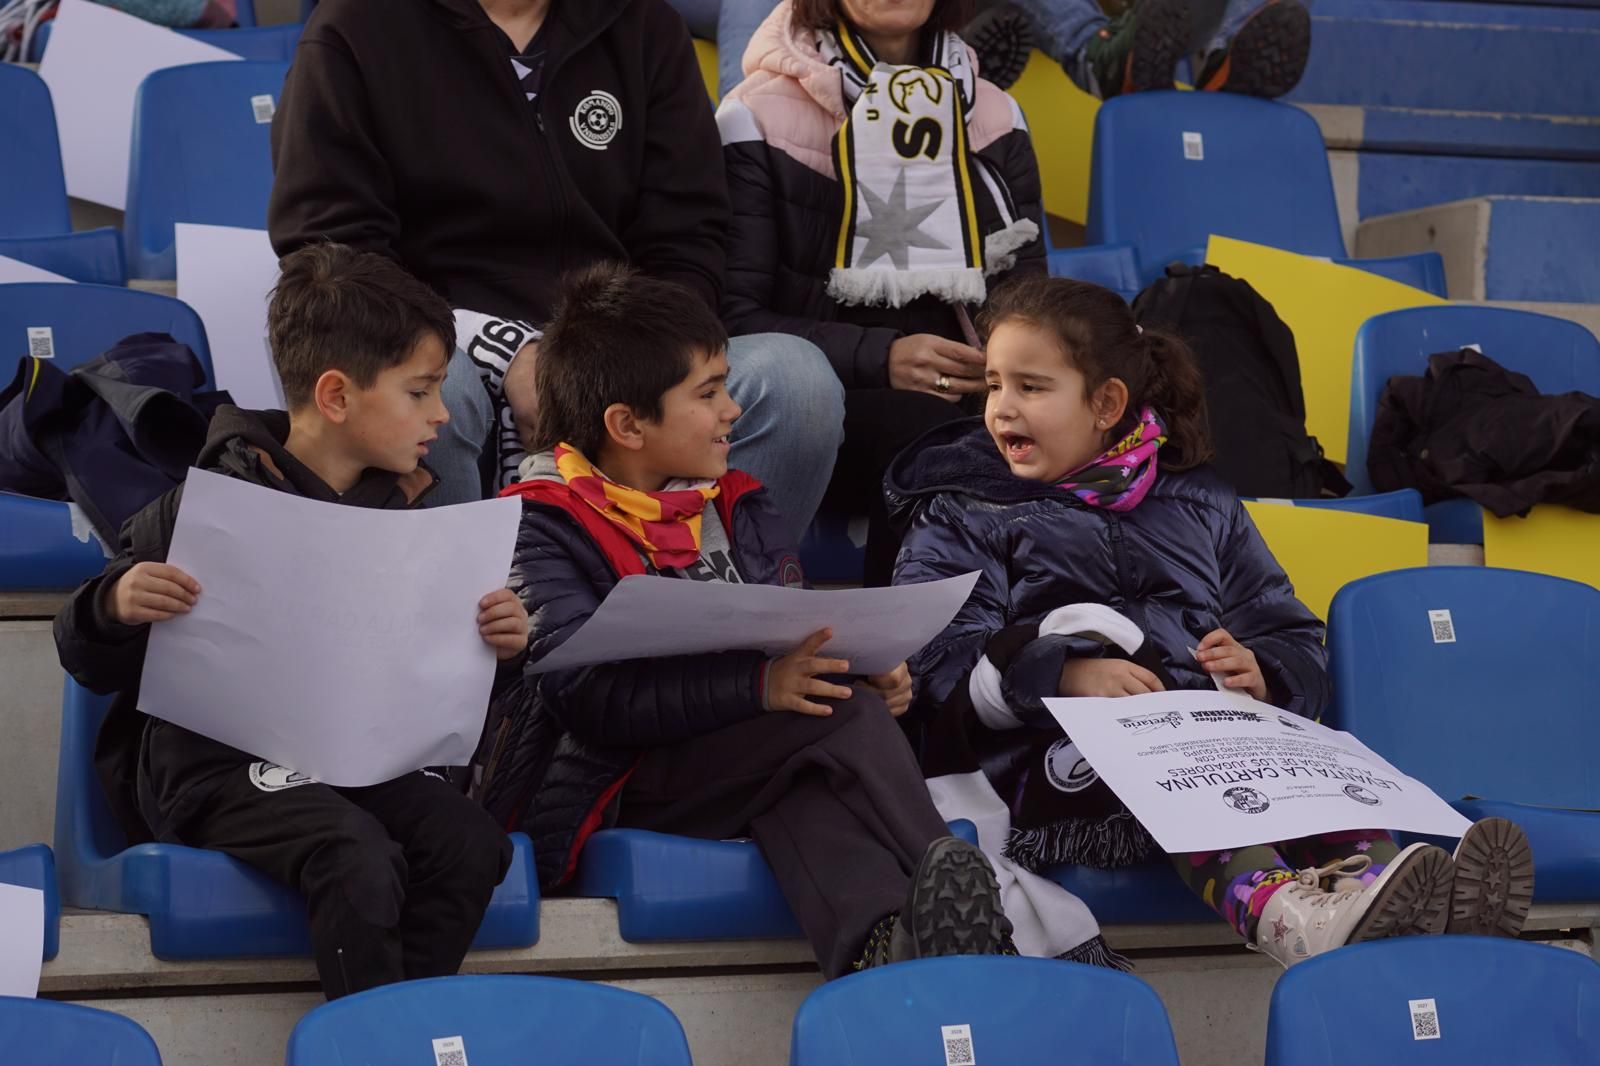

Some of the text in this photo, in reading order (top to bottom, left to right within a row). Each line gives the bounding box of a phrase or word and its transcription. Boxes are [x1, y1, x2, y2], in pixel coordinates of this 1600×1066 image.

[579, 99, 615, 116] KOMANDO
[1190, 710, 1256, 718] MONTSERRAT
[1170, 720, 1181, 729] el
[1183, 748, 1218, 757] EQUIPO
[1220, 745, 1264, 753] NUESTRO
[1194, 755, 1216, 764] CON
[1217, 751, 1259, 760] MOSAICO
[1250, 758, 1278, 767] LOS
[1278, 758, 1298, 766] DE
[1298, 758, 1344, 771] SALIDA
[1168, 760, 1246, 777] JUGADORES
[1156, 766, 1402, 792] LEVANTA LA CARTULINA
